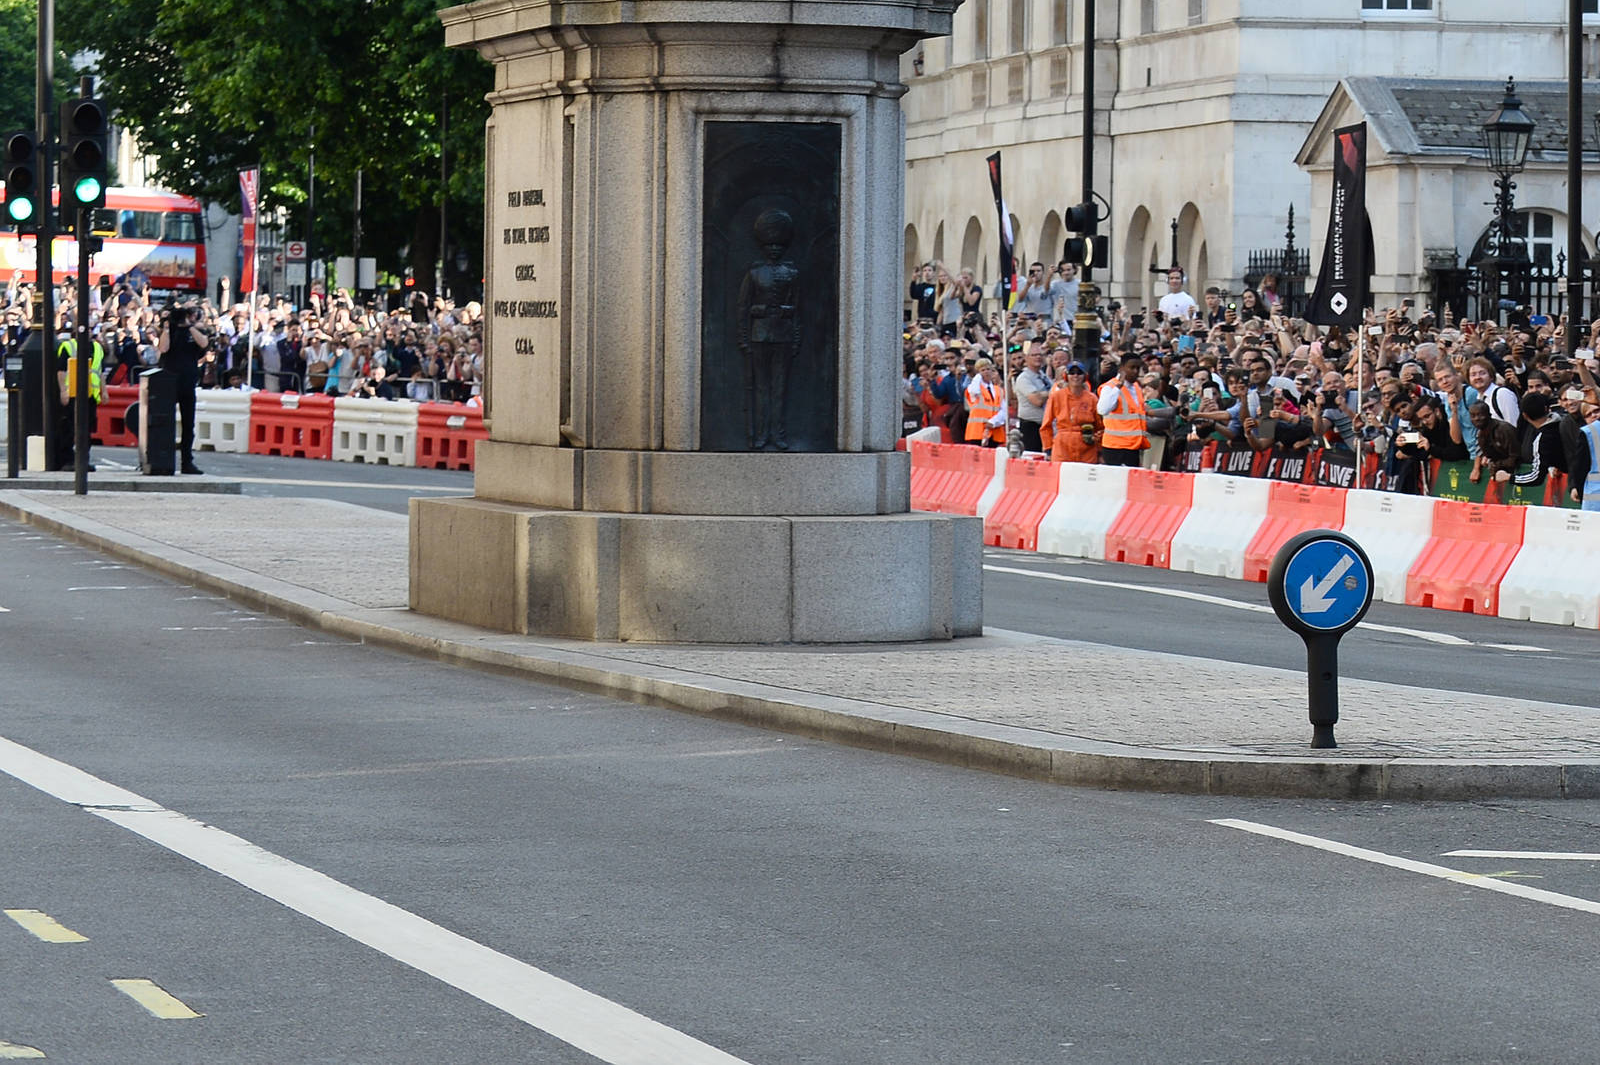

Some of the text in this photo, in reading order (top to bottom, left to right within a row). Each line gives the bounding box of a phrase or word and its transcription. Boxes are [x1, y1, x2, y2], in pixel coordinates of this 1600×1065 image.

[1228, 451, 1253, 472] LIVE
[1281, 458, 1304, 479] LIVE
[1329, 463, 1354, 487] LIVE
